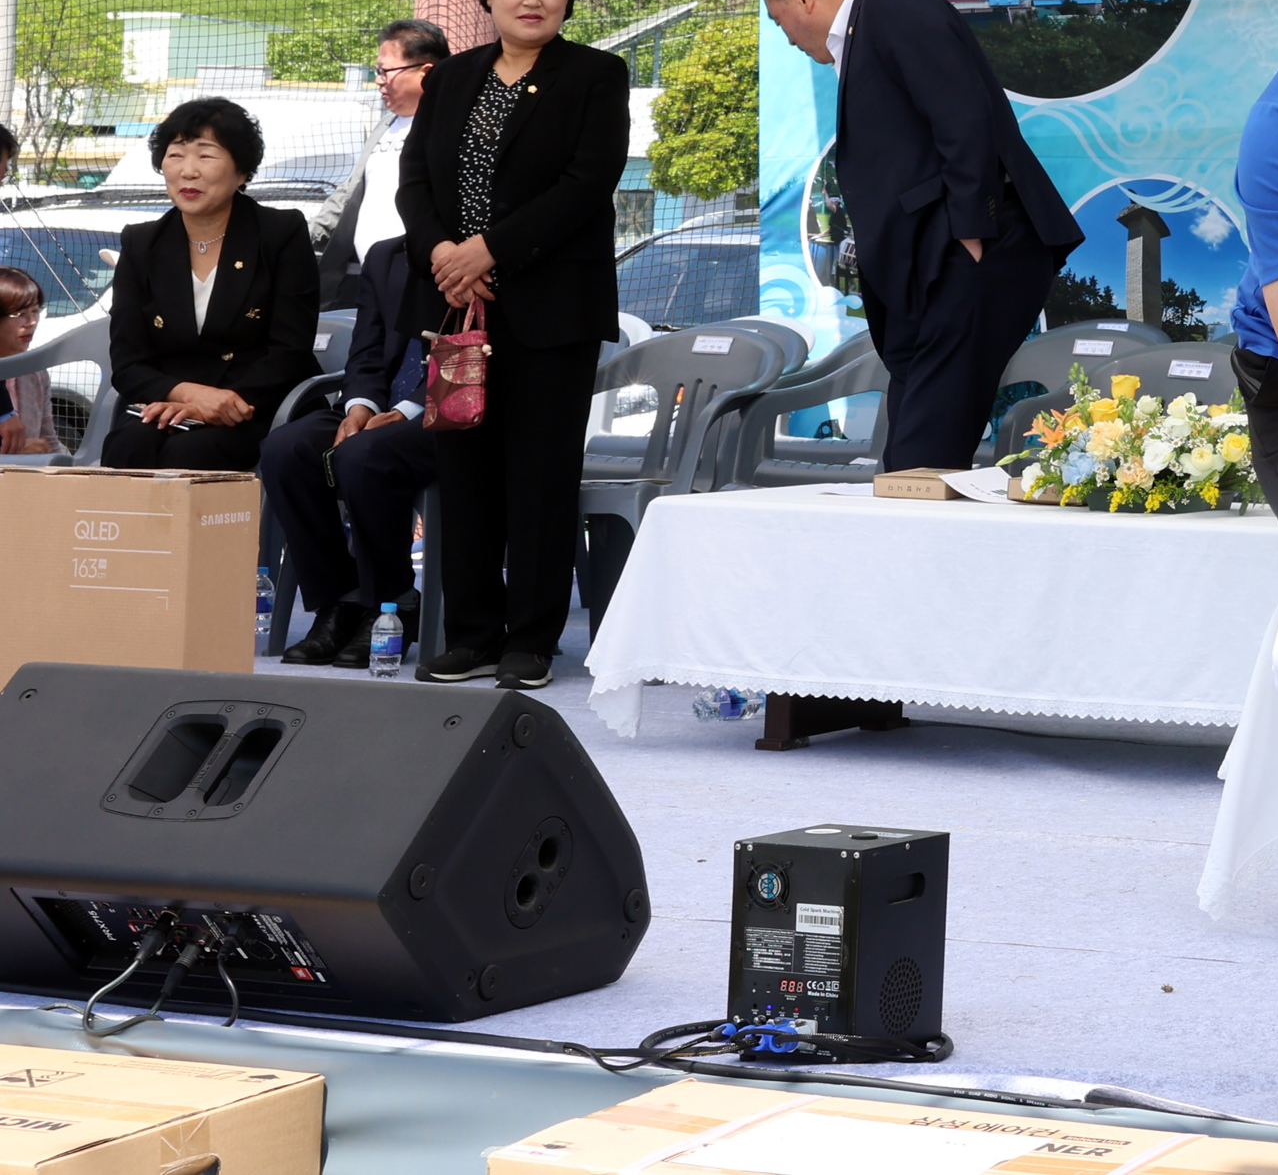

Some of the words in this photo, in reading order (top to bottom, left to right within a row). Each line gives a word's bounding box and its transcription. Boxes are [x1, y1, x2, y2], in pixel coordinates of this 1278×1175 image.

[201, 511, 251, 526] SAMSUNG
[74, 520, 120, 541] QLED
[910, 1116, 971, 1129] 삼성
[973, 1121, 1060, 1137] 에어컨
[1034, 1142, 1114, 1157] NER
